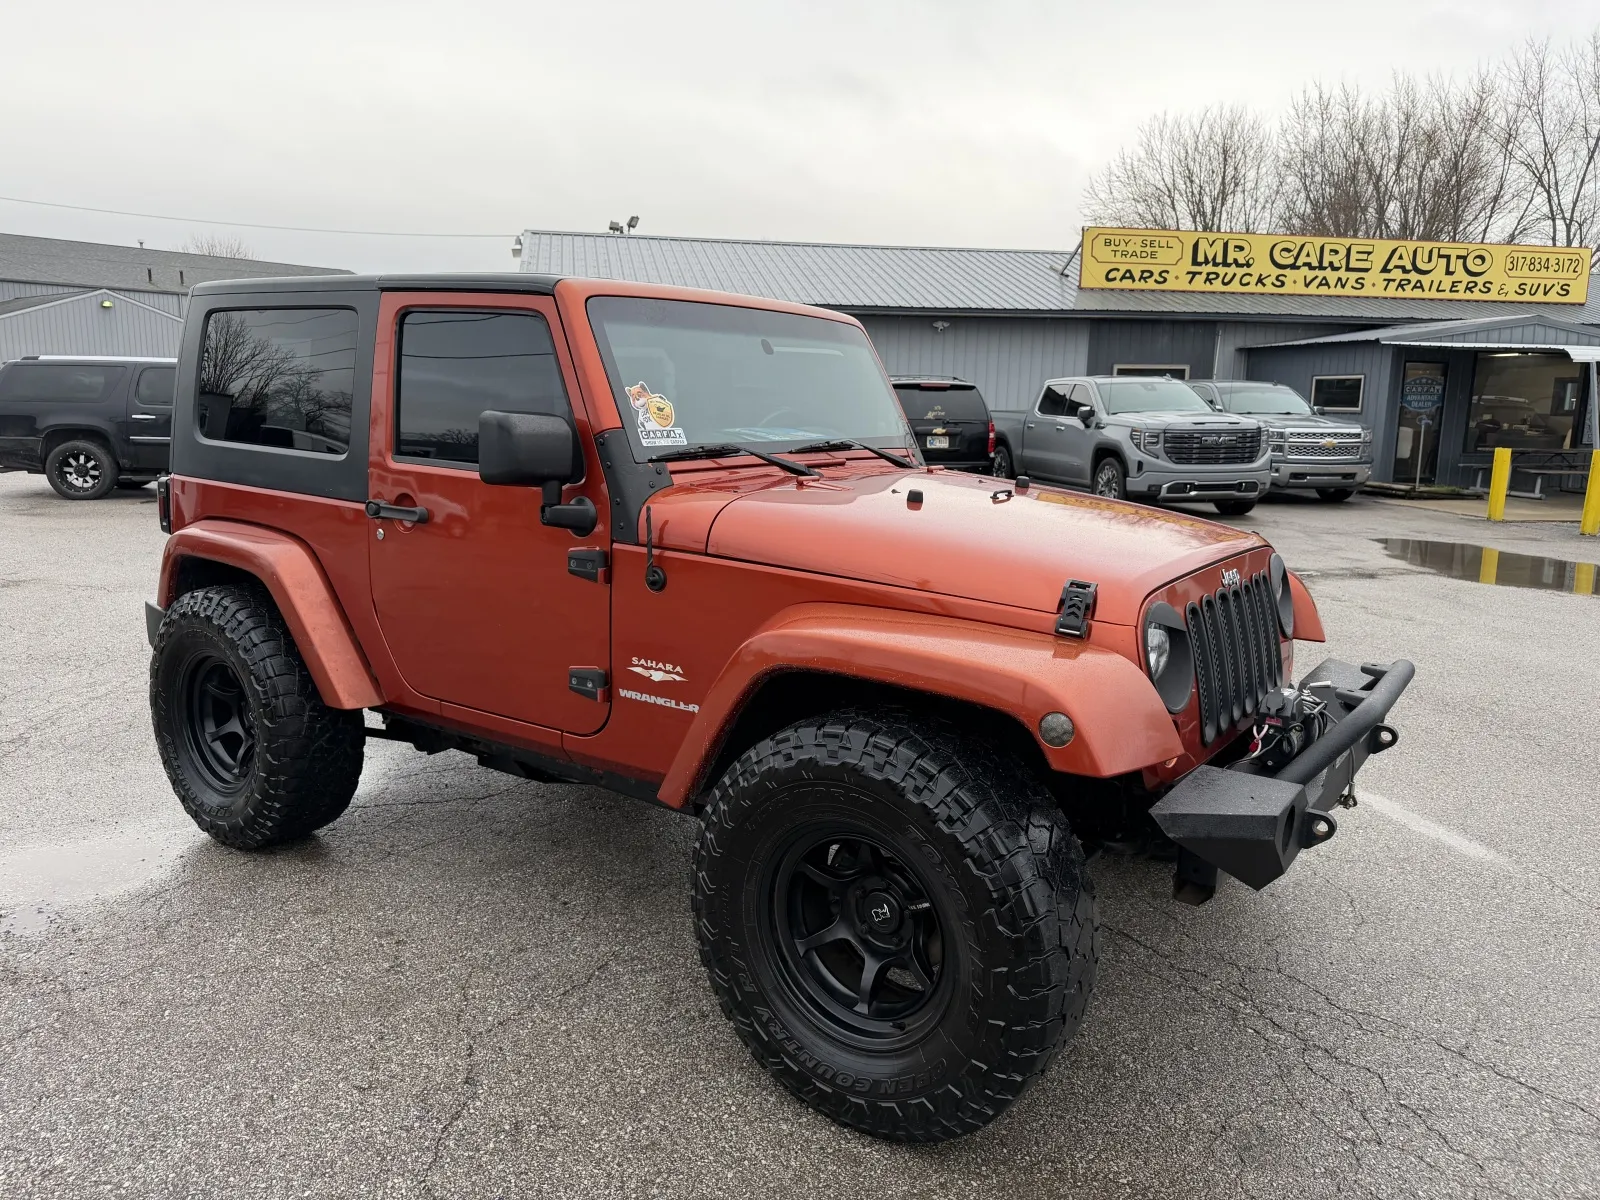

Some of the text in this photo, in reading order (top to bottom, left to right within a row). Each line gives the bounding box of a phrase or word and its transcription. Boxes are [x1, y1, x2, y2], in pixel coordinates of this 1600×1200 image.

[1104, 238, 1174, 249] BUY SELL
[1110, 249, 1159, 260] TRADE
[1191, 237, 1494, 277] MR. CARE AUTO
[1104, 267, 1571, 298] CARS TRUCKS VANS TRAILERS & SUV'S
[641, 430, 684, 440] CARFAX
[1220, 568, 1240, 588] Jeep
[631, 656, 684, 674] SAHARA
[618, 688, 700, 714] WRANGLER
[753, 1005, 873, 1093] COUNTRY
